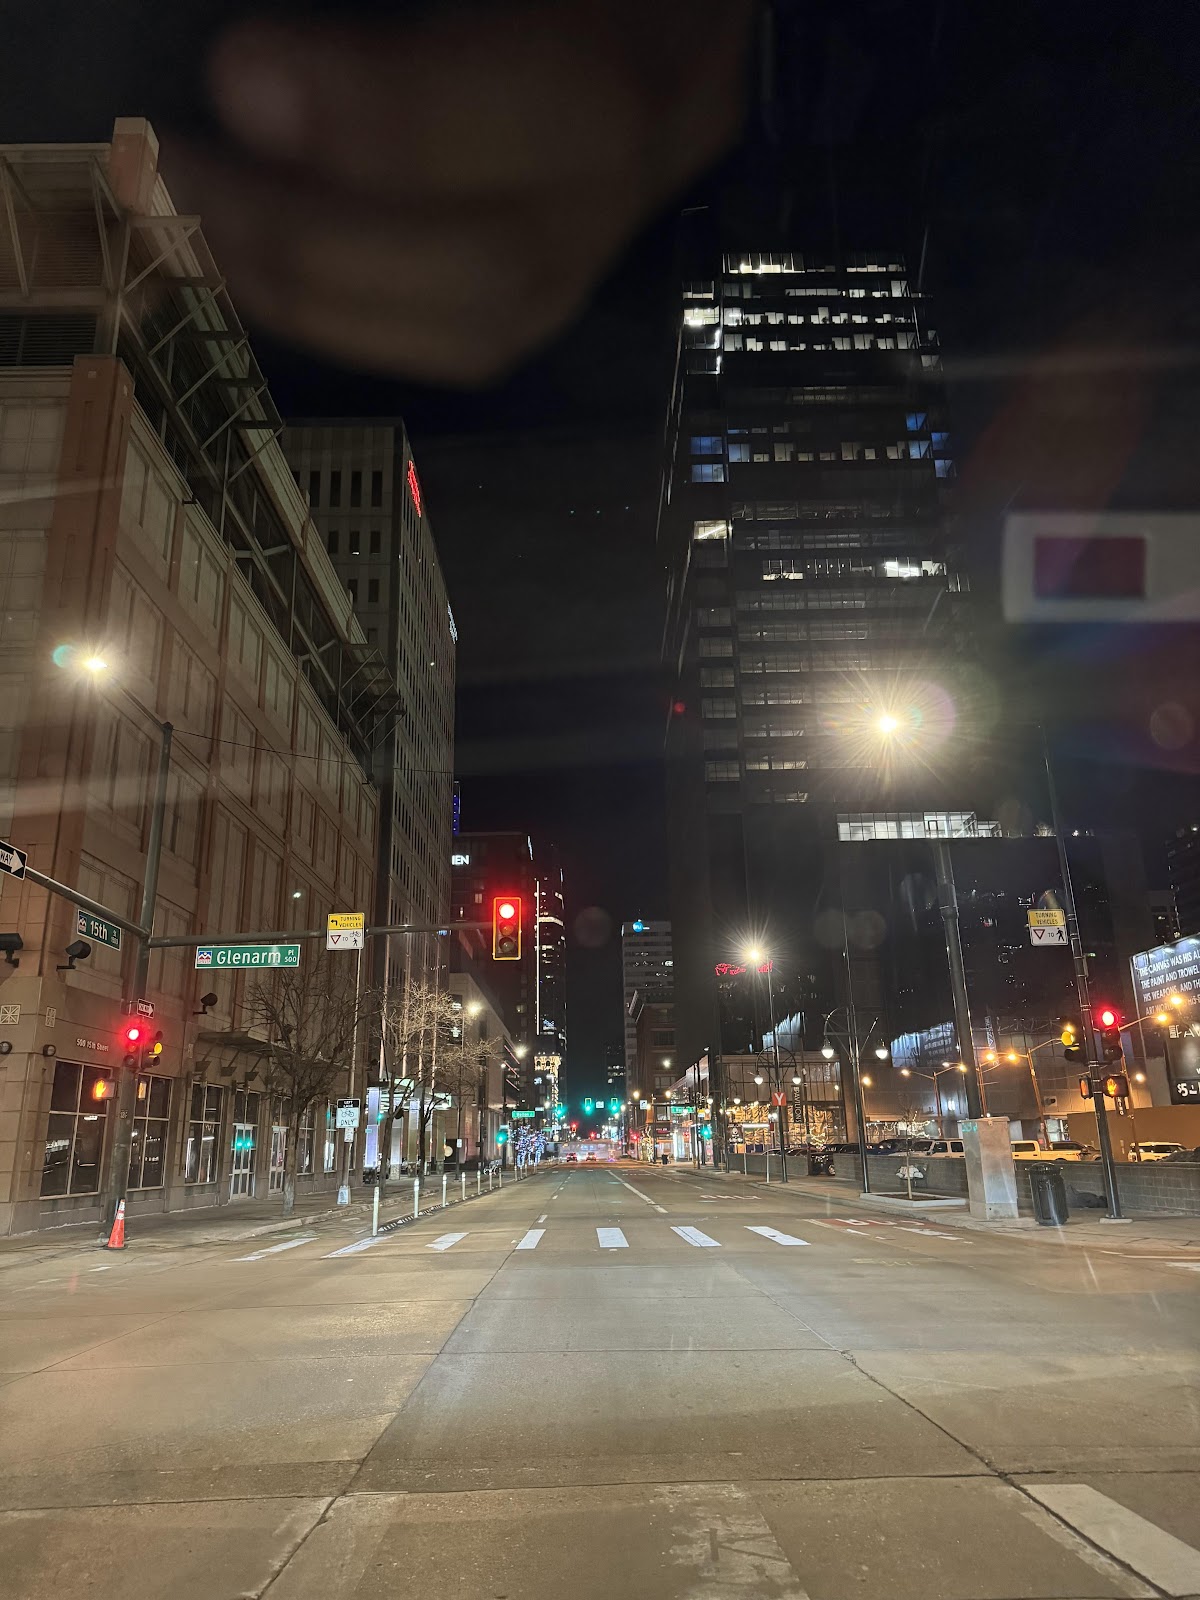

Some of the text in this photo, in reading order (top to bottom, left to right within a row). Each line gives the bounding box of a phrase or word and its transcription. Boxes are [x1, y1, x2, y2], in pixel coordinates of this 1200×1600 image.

[0, 850, 13, 865] WAY
[90, 920, 108, 940] 15th
[216, 949, 281, 965] Glenarm
[1139, 966, 1149, 977] THE
[1148, 961, 1170, 974] CANVAS
[1170, 955, 1183, 967] WAS
[1182, 951, 1192, 964] HIS
[1141, 964, 1200, 990] THE PAINT AND TROWEL
[1143, 992, 1152, 1002] HIS
[1180, 981, 1193, 992] AND
[1145, 1004, 1155, 1016] ART
[1176, 1082, 1189, 1097] $5
[774, 1093, 785, 1106] Y
[794, 1089, 802, 1123] PAVILIONS
